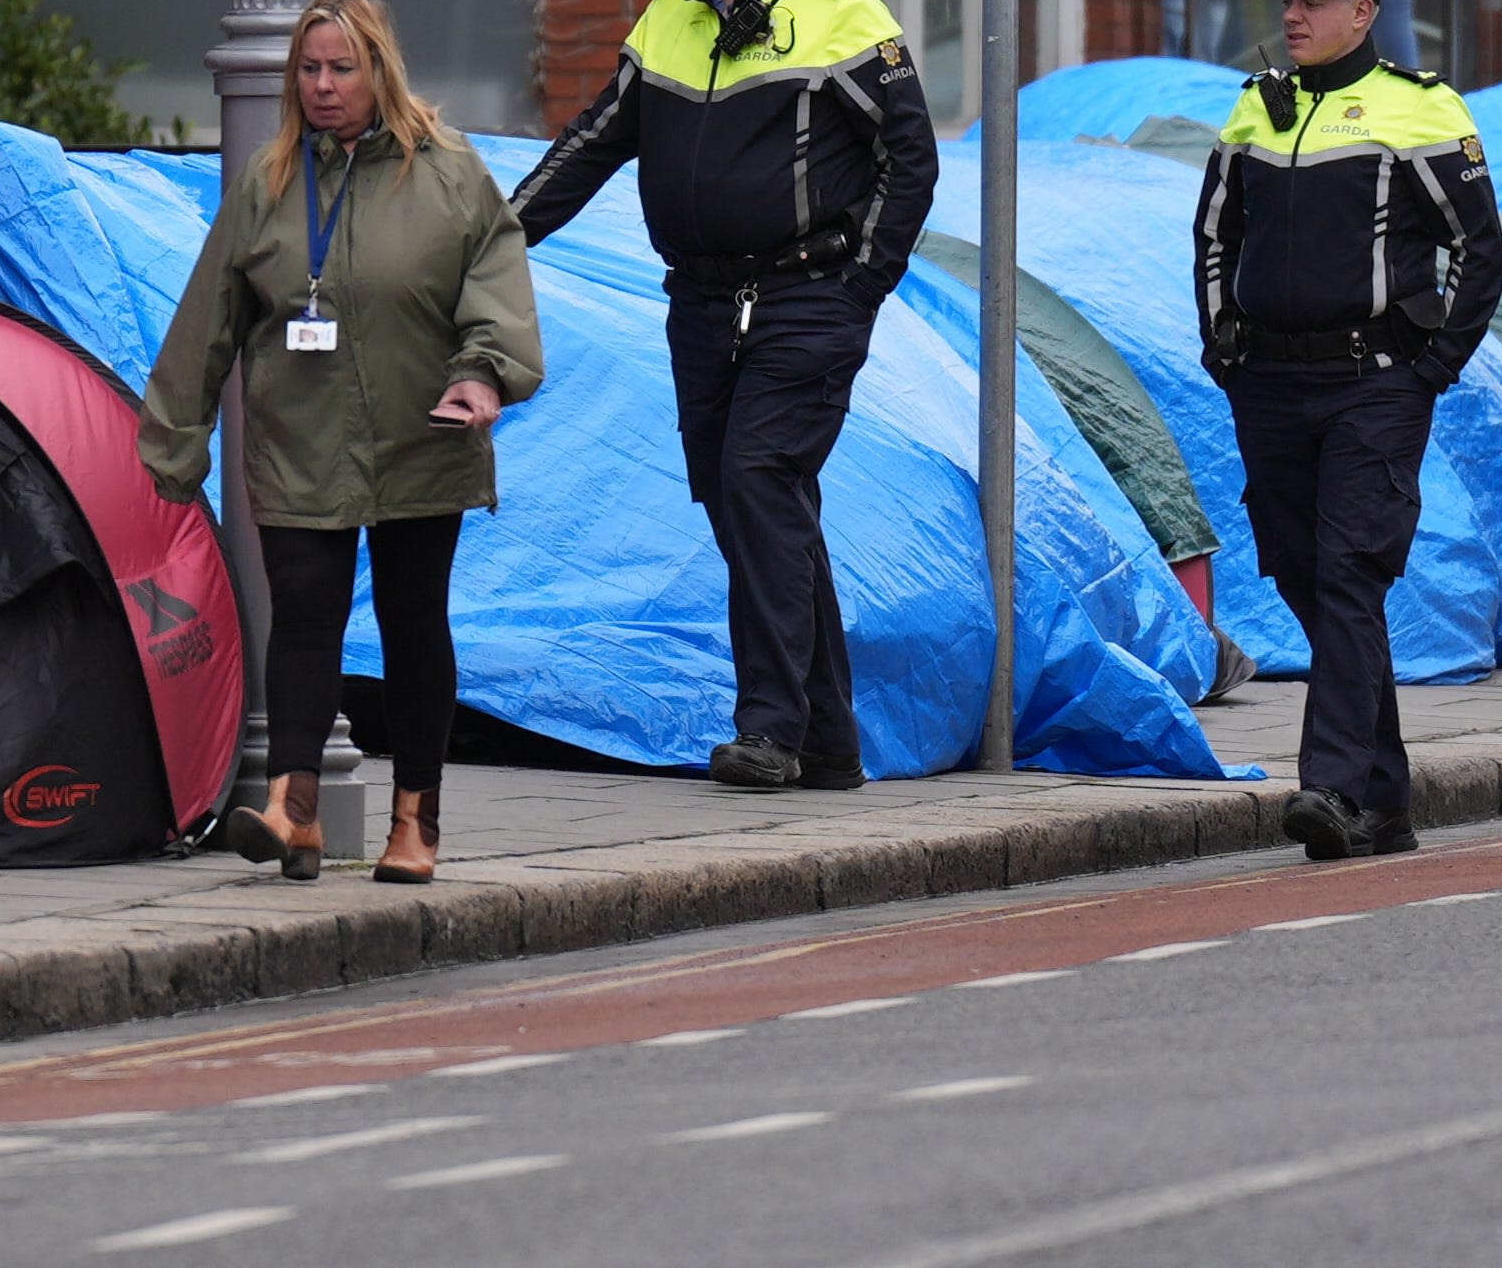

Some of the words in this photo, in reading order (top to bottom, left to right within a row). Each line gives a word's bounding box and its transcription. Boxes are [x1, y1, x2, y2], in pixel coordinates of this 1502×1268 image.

[734, 51, 782, 62] GARDA
[879, 66, 916, 85] GARDA
[1320, 124, 1371, 138] GARDA
[1460, 165, 1489, 182] GAR
[25, 783, 102, 810] SWIFT
